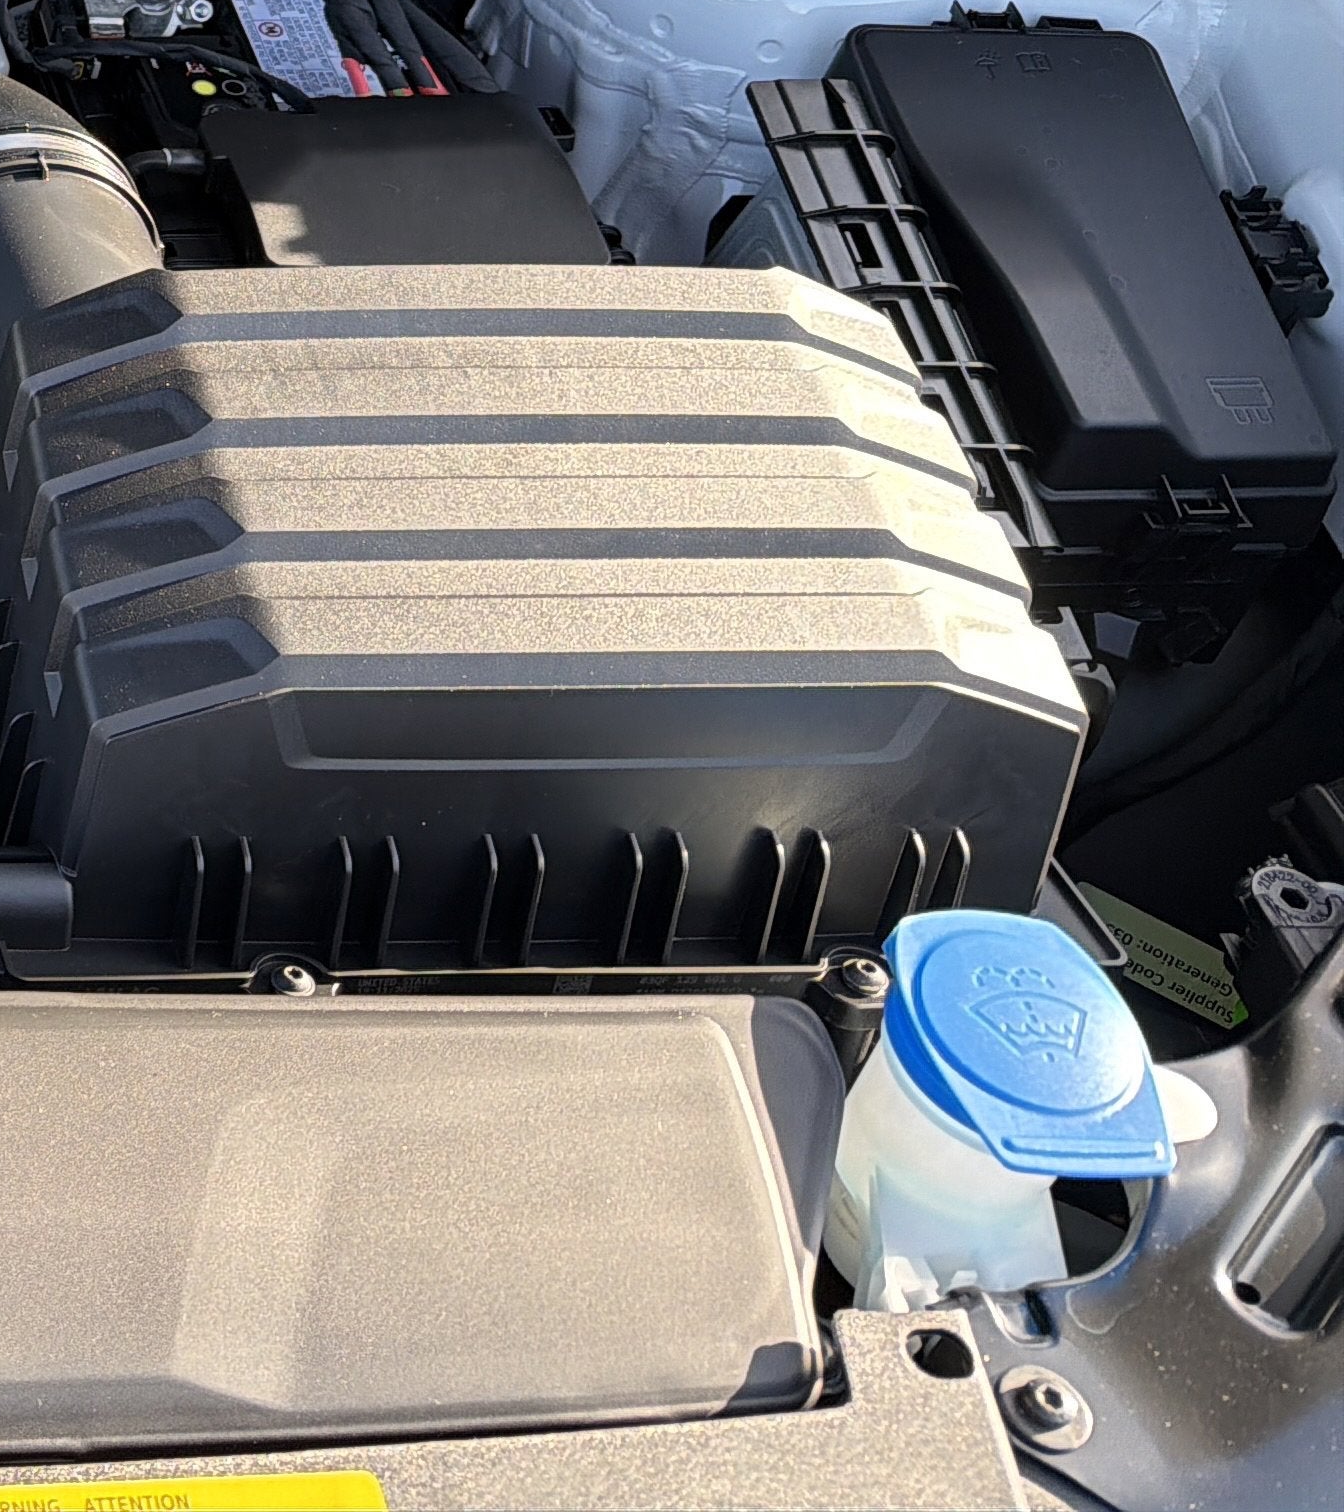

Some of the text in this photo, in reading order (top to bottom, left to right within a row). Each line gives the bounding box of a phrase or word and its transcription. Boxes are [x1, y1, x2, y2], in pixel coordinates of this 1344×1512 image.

[1125, 959, 1234, 1024] Supplier Code
[1136, 939, 1234, 998] Generation:
[84, 1494, 192, 1512] ATTENTION
